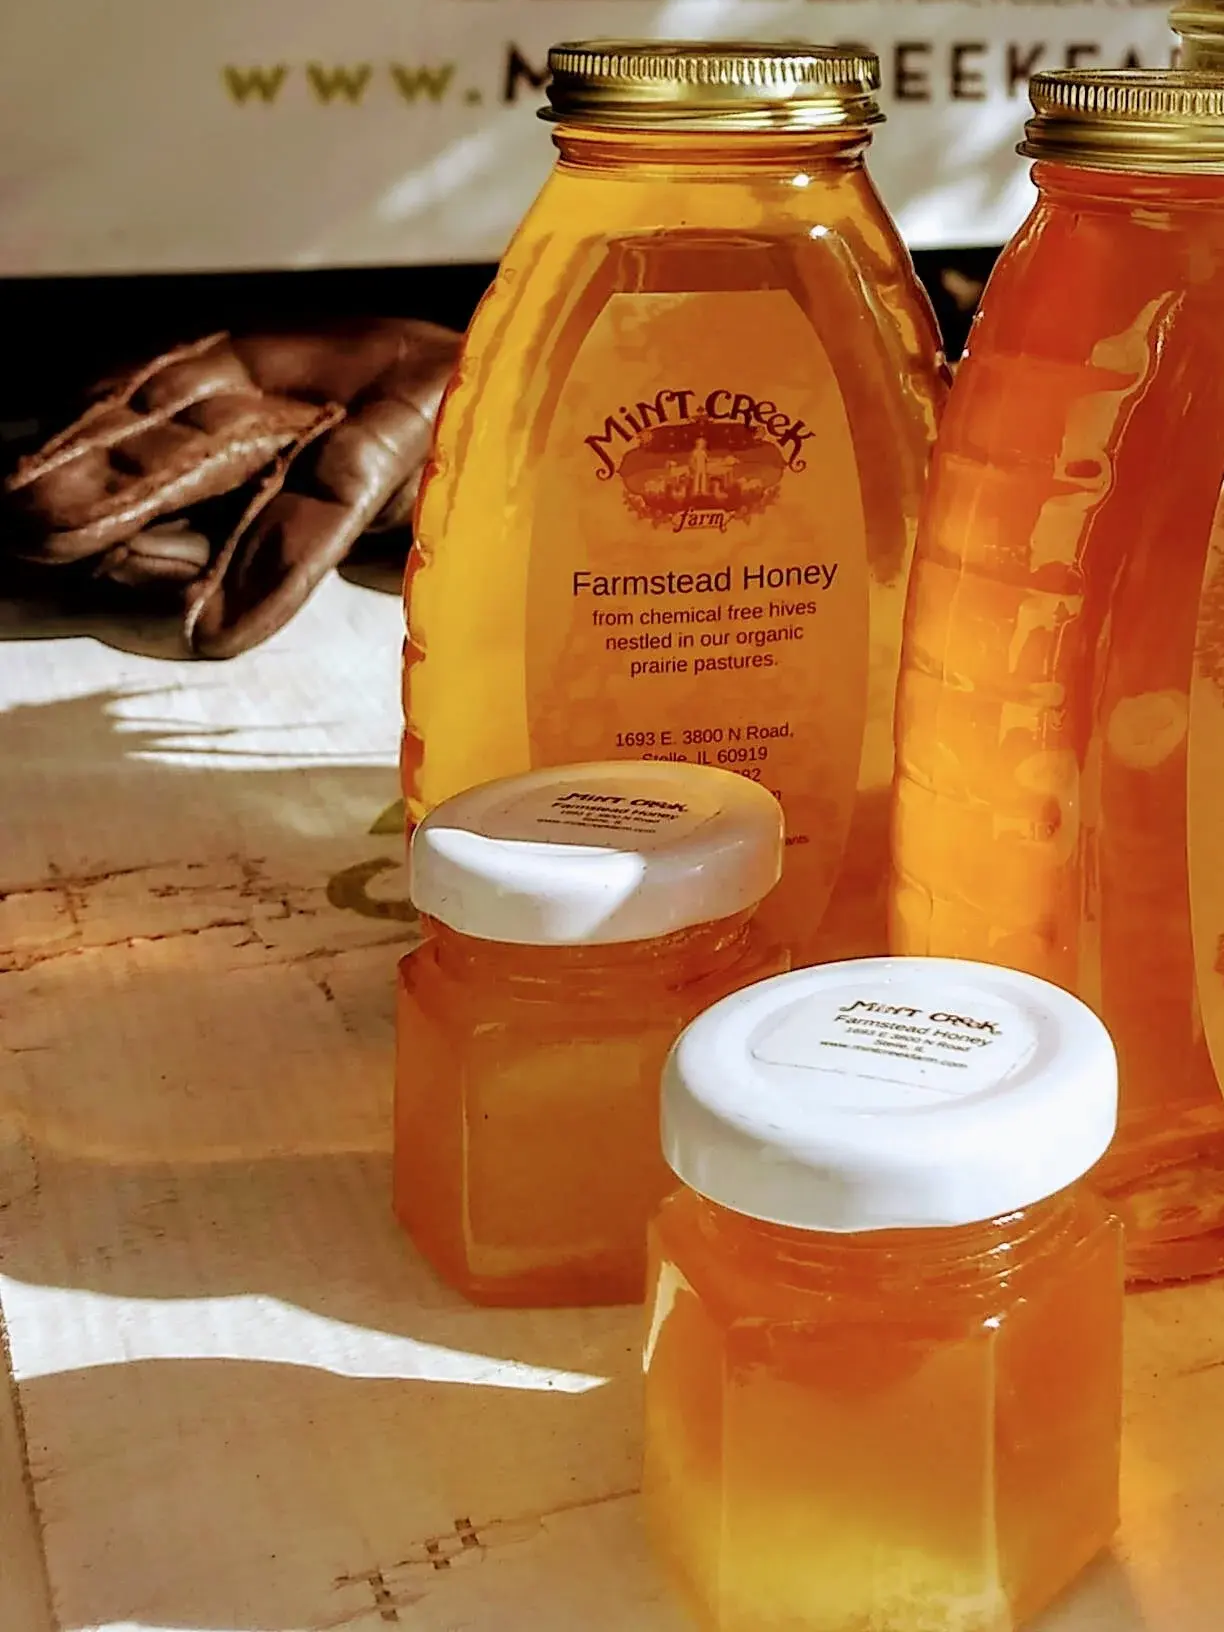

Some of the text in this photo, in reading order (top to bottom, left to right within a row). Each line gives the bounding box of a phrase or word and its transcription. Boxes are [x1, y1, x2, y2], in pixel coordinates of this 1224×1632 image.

[672, 508, 728, 534] farm
[573, 563, 838, 596] Farmstead Honey
[593, 600, 817, 626] from chemical free hives
[606, 624, 804, 651] nestled in our organic
[630, 652, 779, 677] prairie pastures.
[615, 731, 656, 747] 1693
[660, 731, 677, 746] E.
[682, 727, 724, 745] 3800
[728, 727, 742, 741] N
[717, 746, 769, 763] 60919
[551, 802, 630, 814] Farmstead
[631, 809, 679, 821] Honey
[833, 1014, 993, 1048] Farmstead Honey
